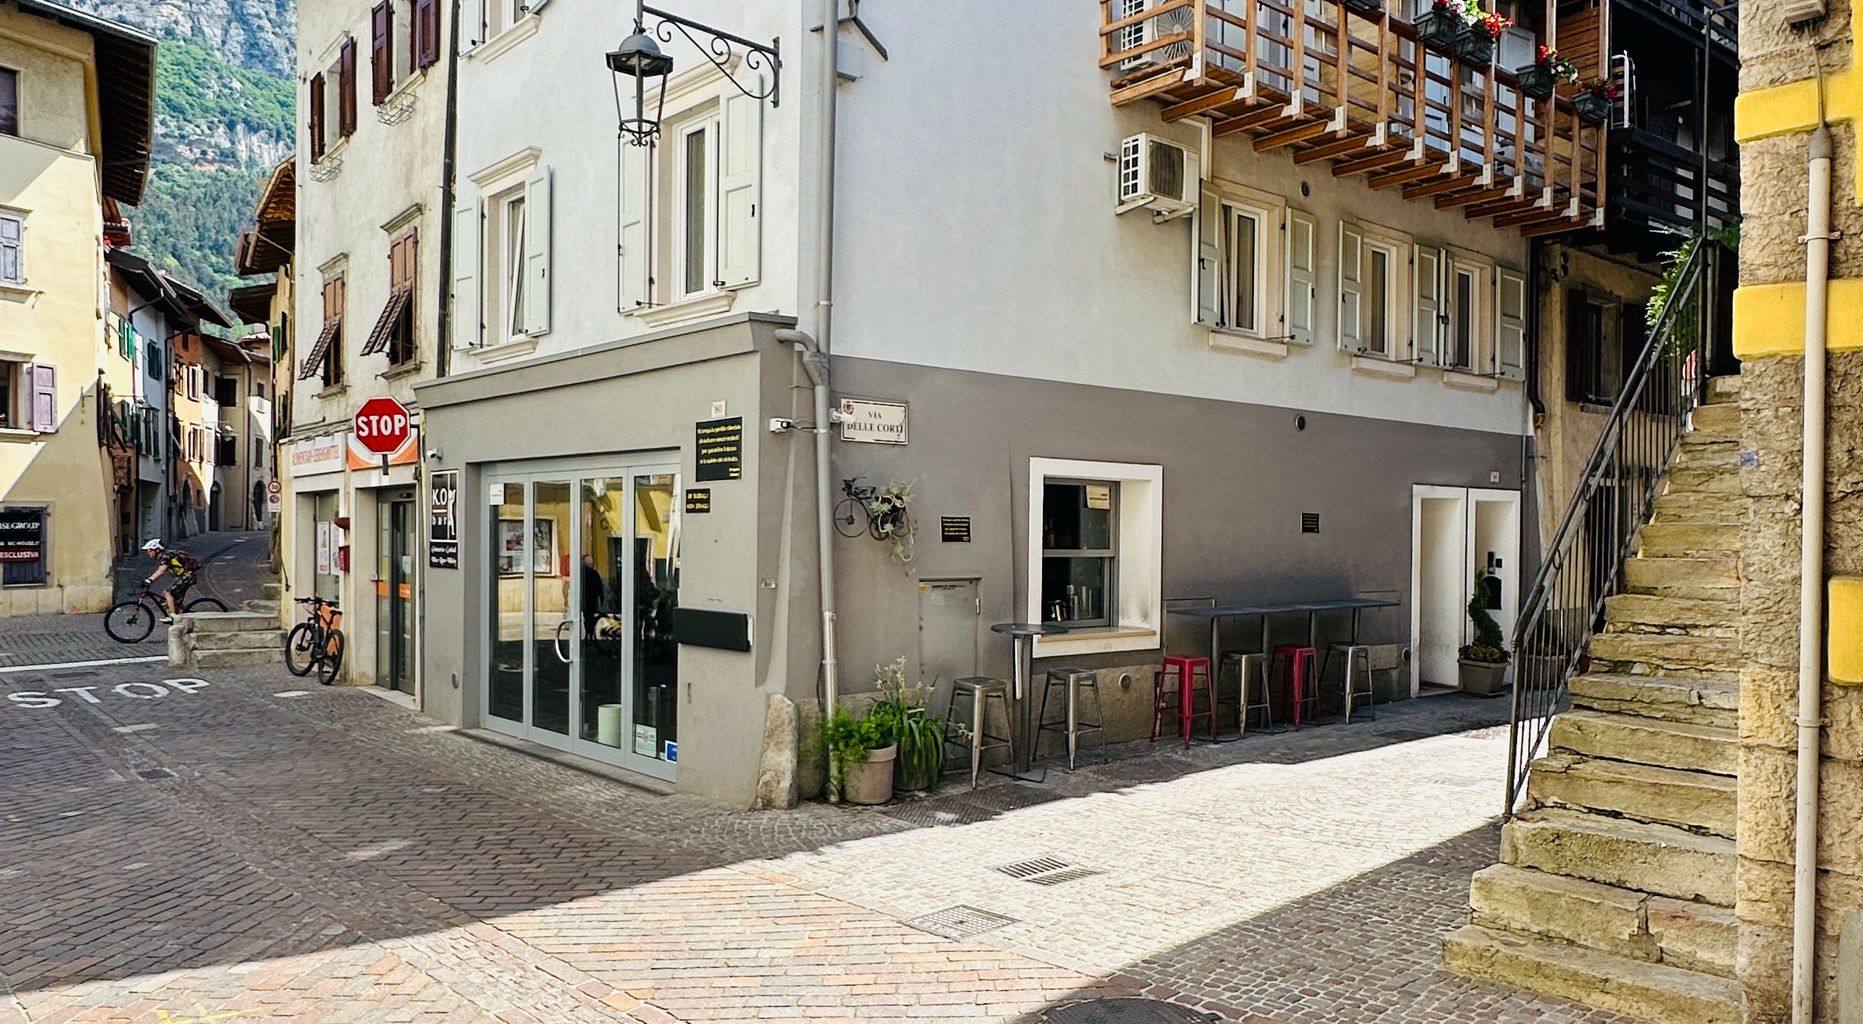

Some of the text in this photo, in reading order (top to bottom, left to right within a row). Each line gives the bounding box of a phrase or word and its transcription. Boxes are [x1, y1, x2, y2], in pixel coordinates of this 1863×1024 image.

[868, 411, 882, 419] VIA
[357, 414, 406, 437] STOP
[847, 421, 875, 432] DELLE
[7, 678, 210, 709] STOP
